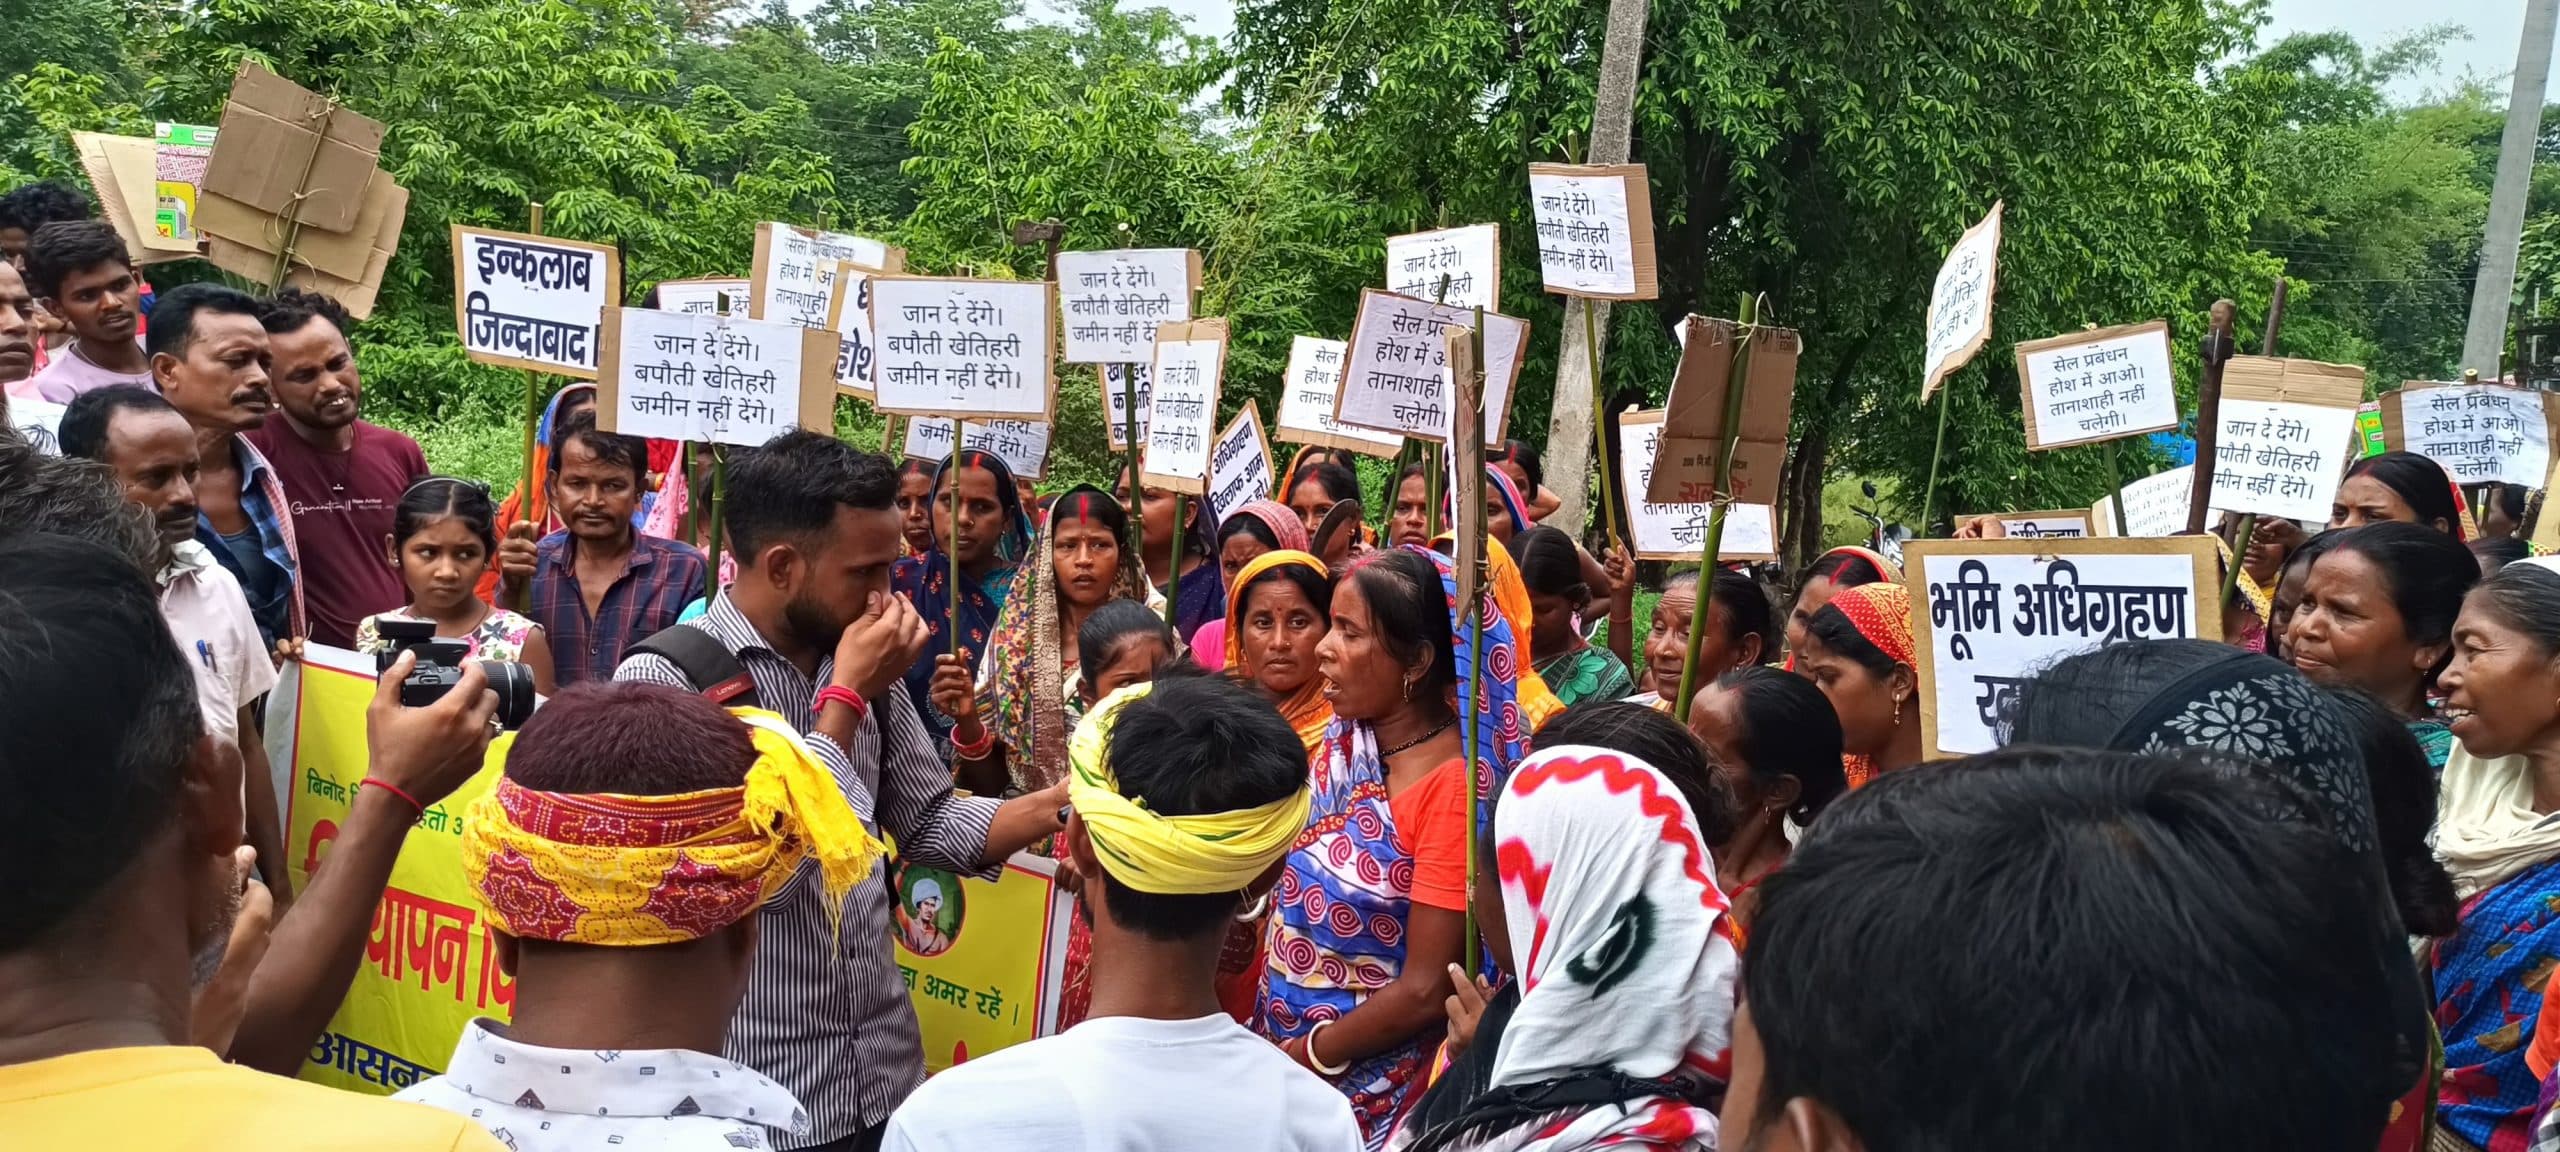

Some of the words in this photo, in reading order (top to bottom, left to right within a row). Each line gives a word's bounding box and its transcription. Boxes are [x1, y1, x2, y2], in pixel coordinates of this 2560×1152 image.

[1541, 195, 1561, 213] जान
[1563, 191, 1571, 213] दे
[1573, 192, 1596, 216] देंगे।
[1567, 220, 1609, 246] खेतिहरी
[475, 237, 593, 292] इन्कलाब
[780, 259, 800, 281] होश
[1404, 256, 1426, 273] जान
[1429, 249, 1437, 269] दे
[1440, 246, 1461, 269] देंगे।
[1540, 244, 1566, 267] जमीन
[1568, 249, 1586, 272] नहीं
[1589, 249, 1614, 273] देंगे।
[1079, 272, 1107, 289] जान
[1112, 266, 1121, 289] दे
[1126, 266, 1156, 288] देंगे।
[902, 304, 942, 324] जान
[948, 300, 960, 325] दे
[966, 300, 1003, 326] देंगे।
[1071, 294, 1110, 315] बपौती
[1114, 293, 1170, 318] खेतिहरी
[1072, 321, 1109, 343] जमीन
[1113, 322, 1139, 345] नहीं
[1392, 308, 1424, 337] सेल
[654, 334, 697, 355] जान
[703, 332, 719, 358] दे
[724, 333, 760, 362] देंगे।
[887, 331, 943, 355] बपौती
[949, 331, 1022, 360] खेतिहरी
[1315, 346, 1339, 364] सेल
[1376, 337, 1411, 363] होश
[1414, 342, 1430, 366] में
[2053, 355, 2079, 374] सेल
[2084, 347, 2128, 368] प्रबंधन
[634, 360, 696, 387] बपौती
[703, 364, 776, 395] खेतिहरी
[887, 361, 940, 386] जमीन
[946, 363, 978, 390] नहीं
[984, 363, 1021, 389] देंगे।
[1304, 366, 1330, 384] होश
[1367, 370, 1444, 399] तानाशाही
[2049, 376, 2077, 398] होश
[2082, 372, 2093, 388] में
[2098, 364, 2144, 386] आओ।
[631, 391, 690, 417] जमीन
[697, 396, 732, 423] नहीं
[738, 398, 774, 425] देंगे।
[1393, 400, 1446, 428] चलेगी।
[2049, 390, 2115, 417] तानाशाही
[2119, 383, 2146, 405] नहीं
[2431, 394, 2460, 412] सेल
[2464, 392, 2511, 411] प्रबंधन
[2078, 411, 2127, 432] चलेगी।
[2226, 419, 2257, 438] जान
[2261, 417, 2273, 439] दे
[2276, 418, 2310, 443] देंगे।
[2424, 417, 2455, 436] होश
[2460, 414, 2474, 433] में
[2481, 414, 2526, 435] आओ।
[999, 435, 1028, 458] देंगे।
[2215, 442, 2252, 465] पौती
[2256, 445, 2321, 472] खेतिहरी
[2424, 434, 2495, 457] तानाशाही
[2498, 436, 2526, 457] नहीं
[1244, 450, 1265, 484] आम
[2212, 468, 2243, 490] मीन
[2247, 472, 2279, 496] नहीं
[2280, 474, 2314, 500] देंगे।
[1930, 559, 2001, 661] भूमि
[2013, 559, 2187, 648] अधिग्रहण
[307, 767, 346, 806] बिनोद
[924, 974, 969, 1008] अमर
[975, 985, 1003, 1020] रहें
